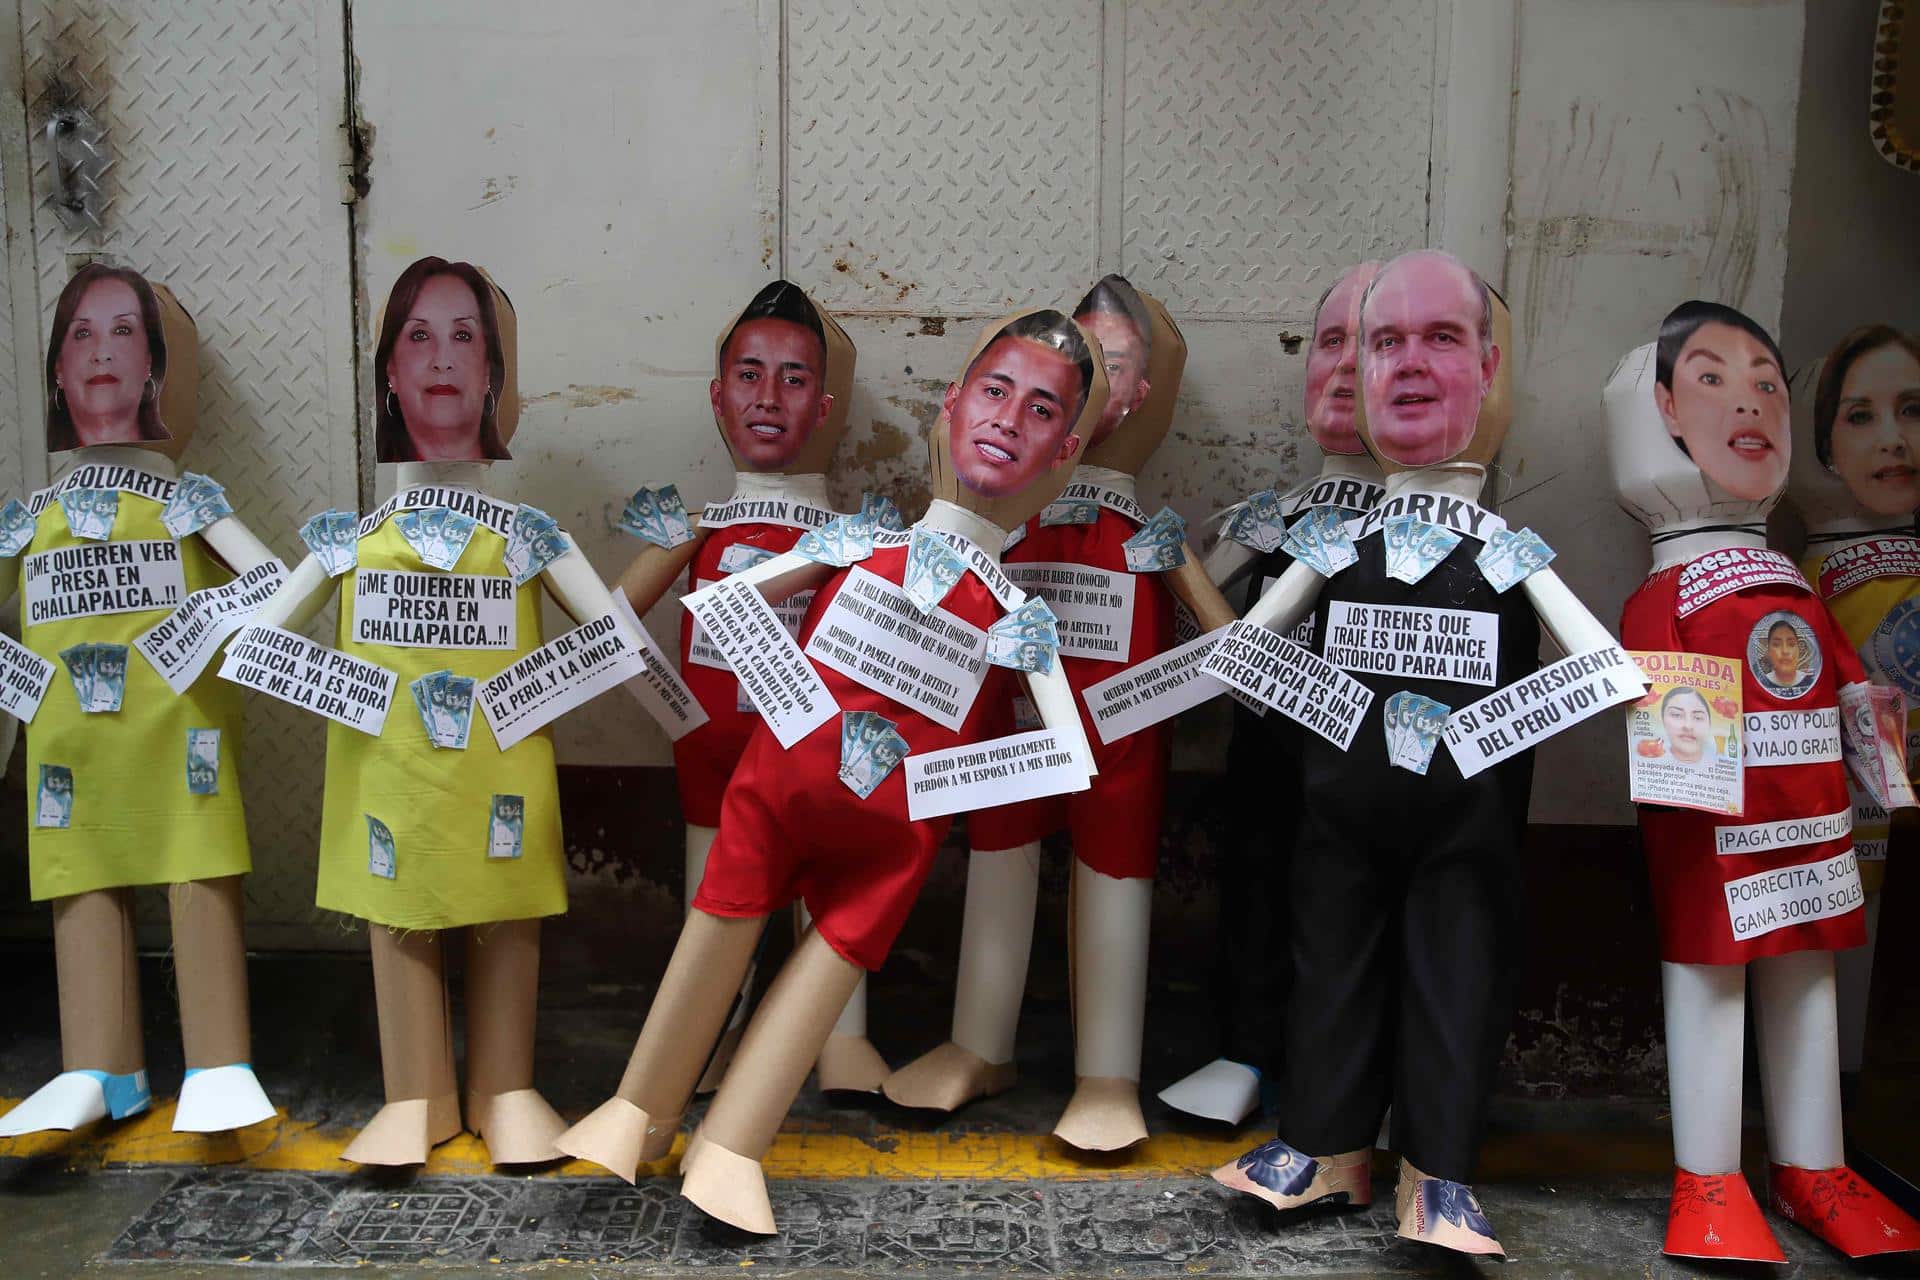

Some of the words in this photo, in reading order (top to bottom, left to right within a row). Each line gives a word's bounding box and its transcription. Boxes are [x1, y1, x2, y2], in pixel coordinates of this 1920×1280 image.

[66, 465, 177, 500] BOLUARTE
[1292, 480, 1386, 512] PORK
[360, 497, 399, 535] DINA
[403, 487, 514, 535] BOLUARTE
[702, 500, 789, 522] CHRISTIAN
[1357, 493, 1487, 538] PORKY
[53, 547, 135, 573] QUIEREN
[140, 542, 177, 562] VER
[971, 550, 1012, 601] CUEVA
[51, 571, 110, 595] PRESA
[116, 566, 141, 587] EN
[218, 584, 239, 599] DE
[239, 560, 279, 590] TODO
[358, 572, 388, 596] ¡¡ME
[393, 574, 475, 599] QUIEREN
[482, 578, 512, 600] VER
[1051, 570, 1075, 586] HABER
[1076, 572, 1111, 589] CONOCIDO
[158, 651, 180, 670] EL
[216, 600, 238, 614] LA
[241, 577, 283, 608] ÚNICA
[388, 598, 449, 621] PRESA
[456, 601, 479, 622] EN
[707, 593, 749, 645] TRAIGAN
[1070, 619, 1104, 636] ARTISTA
[1346, 606, 1369, 627] LOS
[1372, 609, 1433, 632] TRENES
[1438, 614, 1472, 636] QUE
[360, 618, 508, 646] CHALLAPALCA..!!
[555, 634, 578, 656] DE
[575, 614, 616, 645] TODO
[702, 612, 731, 648] CUEVA
[733, 580, 782, 643] CERVECERO
[779, 641, 795, 660] YO
[790, 659, 813, 684] SOY
[834, 591, 866, 618] PERSONAS
[863, 605, 874, 622] DE
[873, 611, 898, 633] OTRO
[921, 634, 937, 653] QUE
[934, 642, 948, 659] NO
[944, 647, 962, 665] SON
[957, 653, 969, 669] EL
[909, 609, 920, 623] ES
[919, 609, 947, 636] HABER
[944, 624, 979, 650] CONOCIDO
[1075, 636, 1119, 652] APOYARLA
[1333, 625, 1367, 648] TRAJE
[1371, 630, 1389, 650] ES
[1394, 632, 1418, 652] UN
[1422, 635, 1487, 659] AVANCE
[305, 646, 328, 667] MI
[328, 654, 389, 691] PENSIÓN
[725, 591, 750, 623] VIDA
[745, 621, 761, 638] SE
[757, 639, 772, 655] VA
[767, 653, 815, 714] ACABANDO
[827, 624, 857, 648] ADMIRO
[862, 643, 897, 669] PAMELA
[896, 659, 921, 681] COMO
[919, 670, 953, 697] ARTISTA
[1228, 620, 1245, 638] MI
[1240, 623, 1340, 690] CANDIDATURA
[1351, 684, 1370, 710] LA
[1326, 645, 1397, 672] HISTORICO
[1401, 654, 1447, 677] PARA
[1453, 659, 1493, 682] LIMA
[1631, 655, 1736, 684] POLLADA
[6, 668, 42, 701] HORA
[236, 663, 267, 686] QUE
[266, 674, 293, 697] ME
[293, 684, 313, 706] LA
[325, 675, 346, 695] ES
[346, 684, 387, 712] HORA
[492, 702, 511, 722] EL
[559, 659, 580, 684] LA
[579, 635, 626, 669] ÚNICA
[812, 634, 834, 654] COMO
[832, 645, 858, 669] MUJER.
[858, 660, 897, 687] SIEMPRE
[895, 676, 914, 696] VOY
[918, 690, 961, 719] APOYARLA
[1102, 680, 1134, 703] QUIERO
[1133, 667, 1162, 689] PEDIR
[1140, 688, 1153, 702] MI
[1153, 675, 1185, 698] ESPOSA
[1219, 637, 1307, 694] PRESIDENCIA
[1308, 682, 1329, 706] ES
[1327, 694, 1357, 726] UNA
[1459, 711, 1481, 734] SI
[1480, 692, 1517, 724] SOY
[1515, 646, 1624, 706] PRESIDENTE
[1673, 674, 1721, 691] PASAJES
[1205, 653, 1263, 693] ENTREGA
[1276, 689, 1300, 714] LA
[1298, 702, 1350, 746] PATRIA
[1635, 710, 1650, 721] 20
[1476, 728, 1514, 758] DEL
[1511, 699, 1562, 740] PERÚ
[1560, 682, 1599, 714] VOY
[1770, 714, 1799, 731] SOY
[923, 757, 956, 776] QUIERO
[957, 751, 988, 769] PEDIR
[989, 736, 1057, 763] PÚBLICAMENTE
[1752, 739, 1798, 758] VIAJO
[959, 771, 972, 786] MI
[973, 766, 1009, 783] ESPOSA
[1027, 757, 1044, 772] MIS
[1045, 751, 1073, 769] HIJOS
[1719, 826, 1771, 853] ¡PAGA
[1729, 867, 1823, 905] POBRECITA,
[1827, 854, 1856, 882] SOLO
[1734, 905, 1777, 934] GANA
[1781, 896, 1822, 921] 3000
[1827, 882, 1862, 911] SOLES
